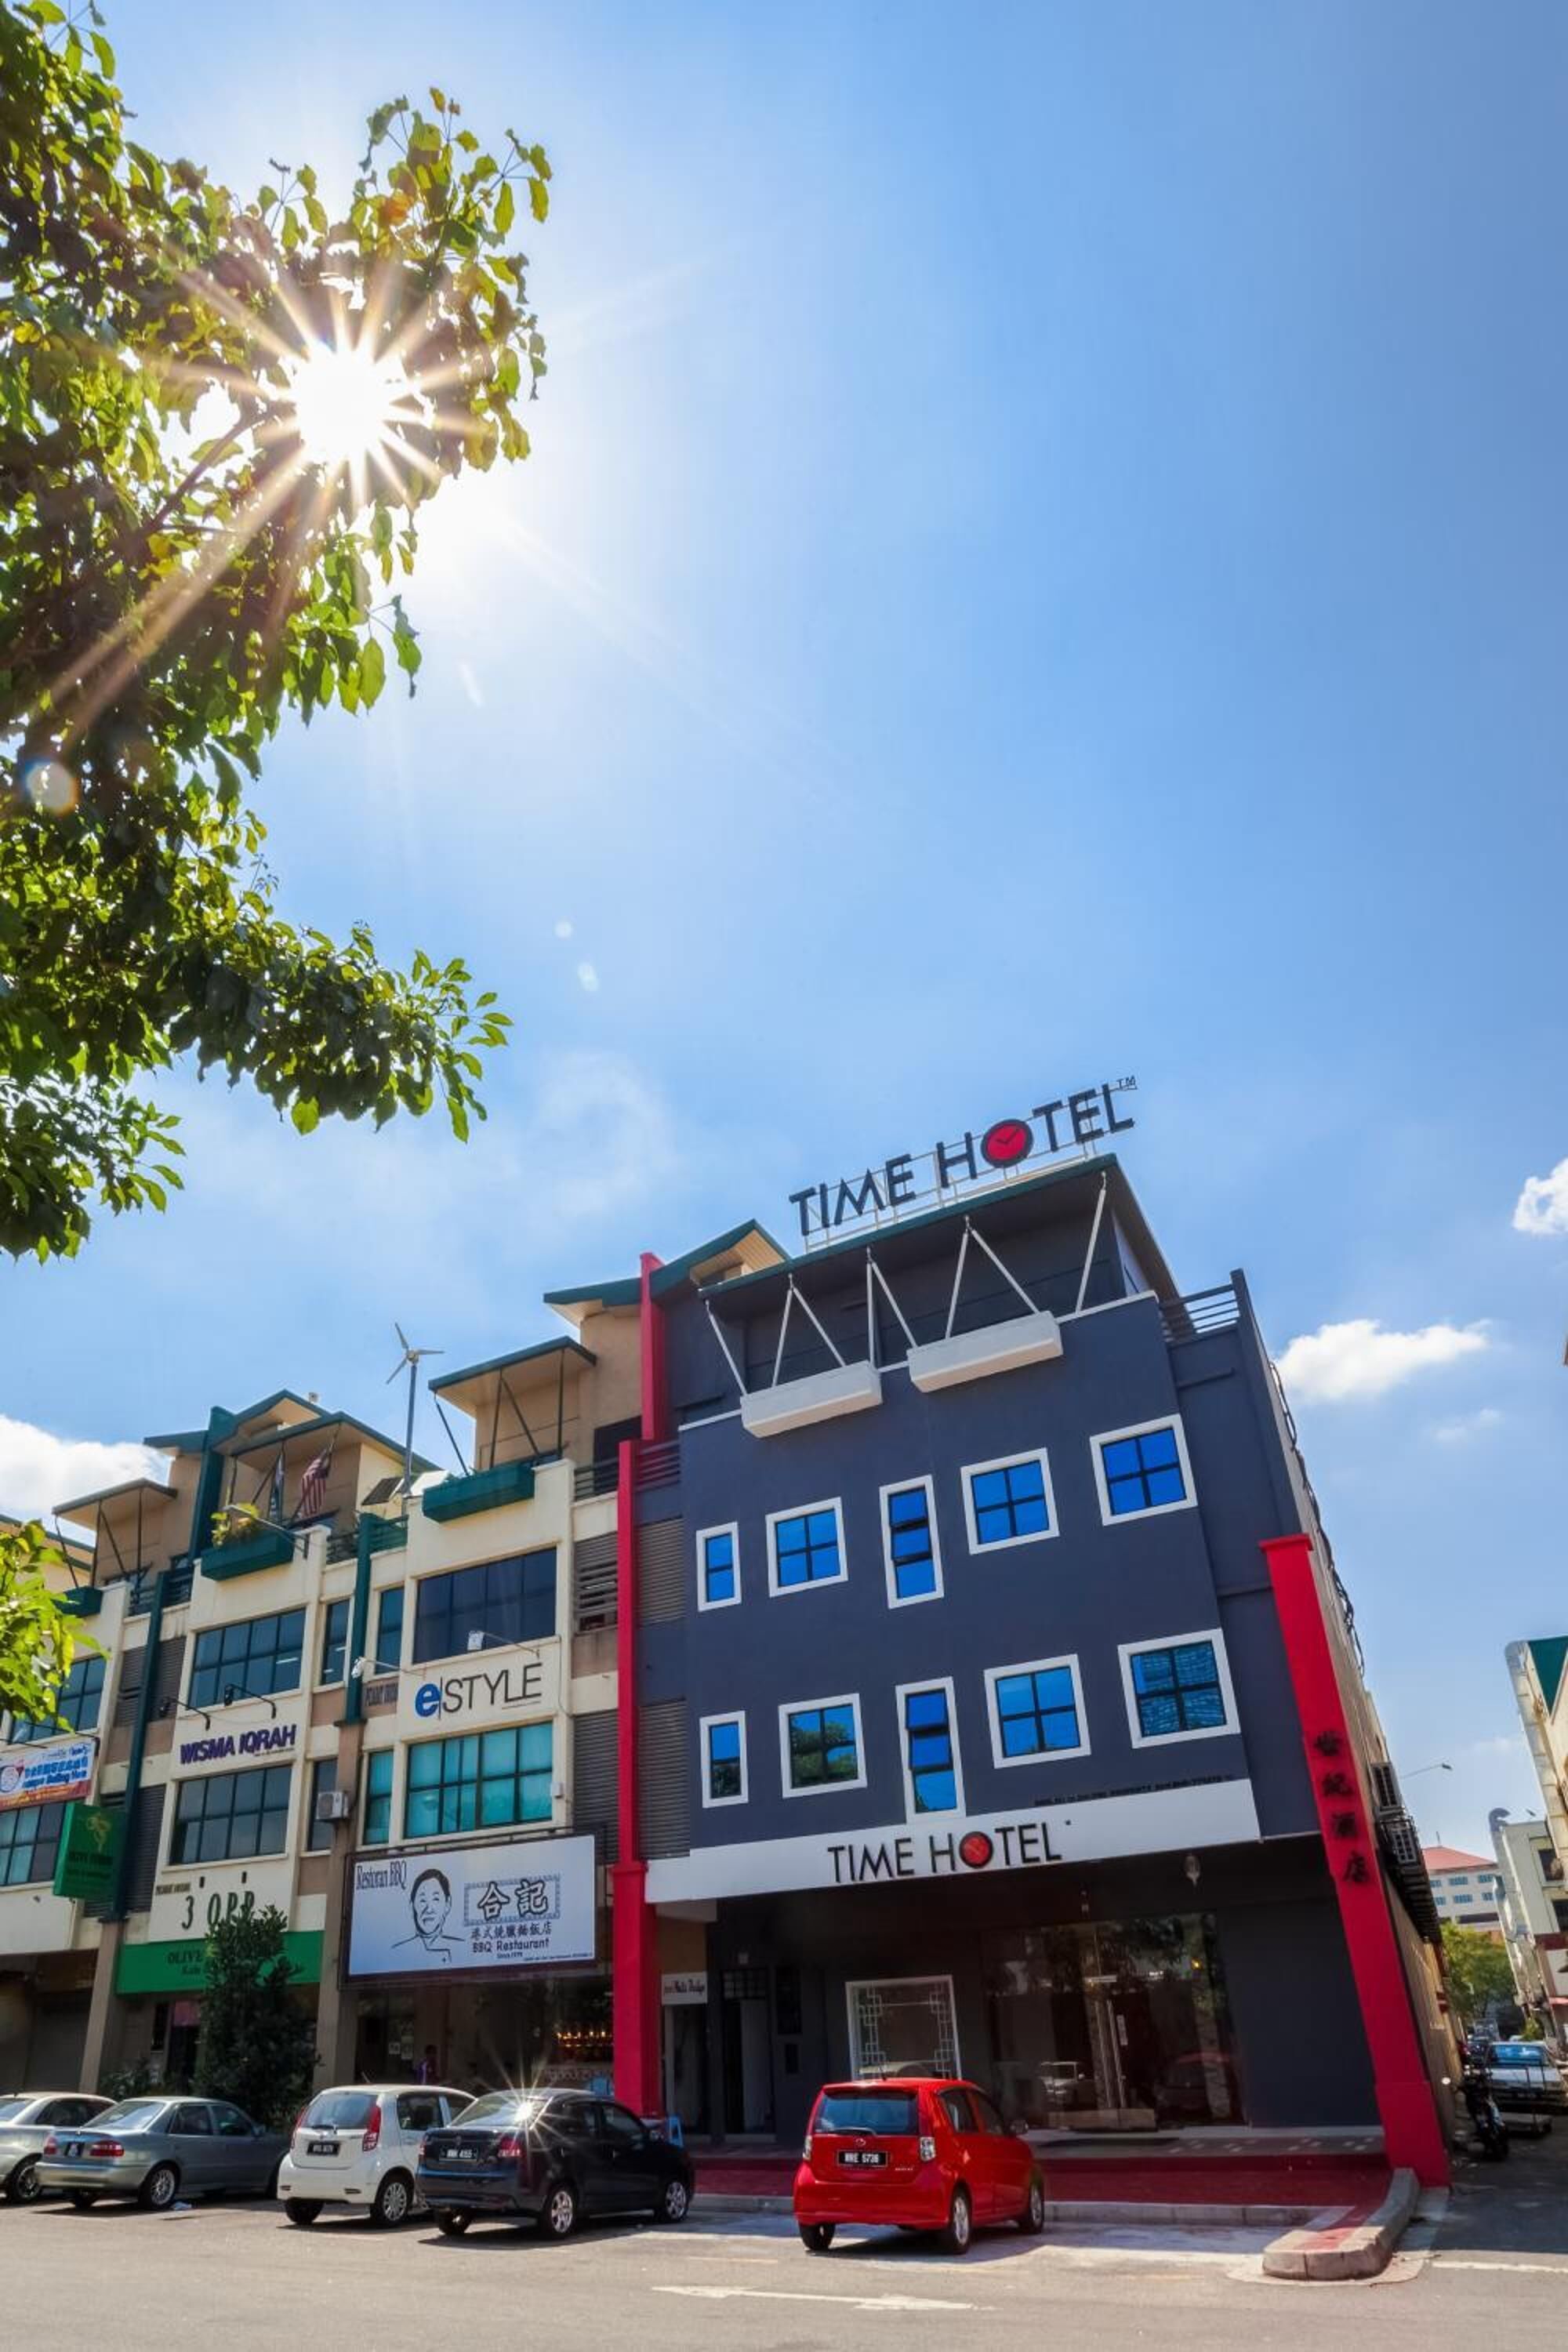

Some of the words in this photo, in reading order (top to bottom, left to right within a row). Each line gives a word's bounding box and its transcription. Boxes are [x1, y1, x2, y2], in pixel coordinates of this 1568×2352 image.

[789, 1153, 916, 1236] TIME
[936, 1083, 1134, 1188] HOTEL
[180, 1736, 235, 1764] WISMA
[238, 1724, 296, 1754] IQRAH
[828, 1838, 914, 1882] TIME
[929, 1822, 1062, 1873] HOTEL
[390, 1859, 407, 1890] BBQ
[477, 1879, 549, 1920] 合記
[473, 1942, 492, 1953] BBQ
[496, 1938, 550, 1951] Restaurant
